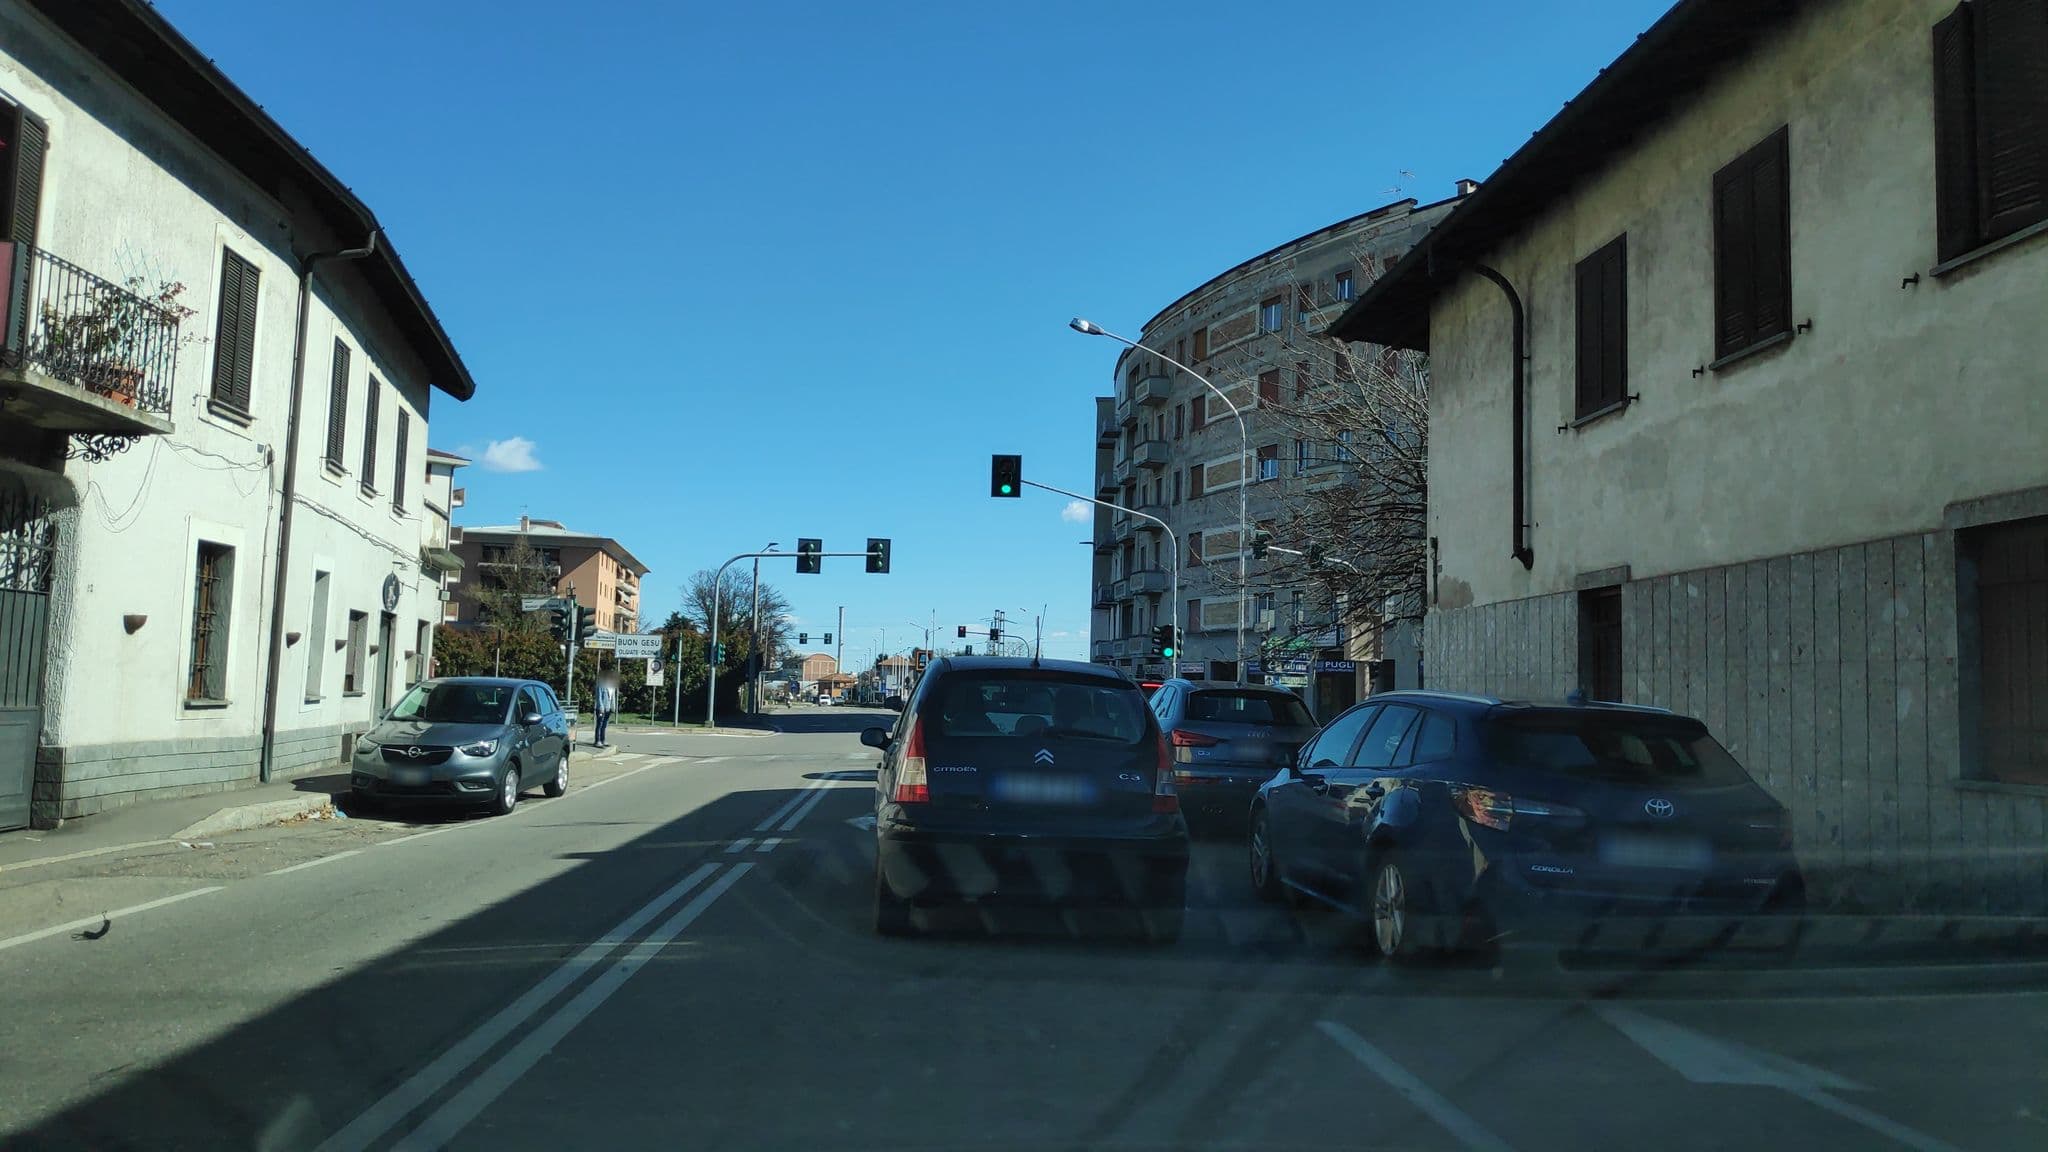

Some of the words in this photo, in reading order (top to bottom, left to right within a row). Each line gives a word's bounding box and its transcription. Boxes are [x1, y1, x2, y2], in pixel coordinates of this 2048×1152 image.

[618, 638, 638, 646] BUON
[1118, 773, 1141, 782] C3
[1530, 864, 1574, 875] COROLLA
